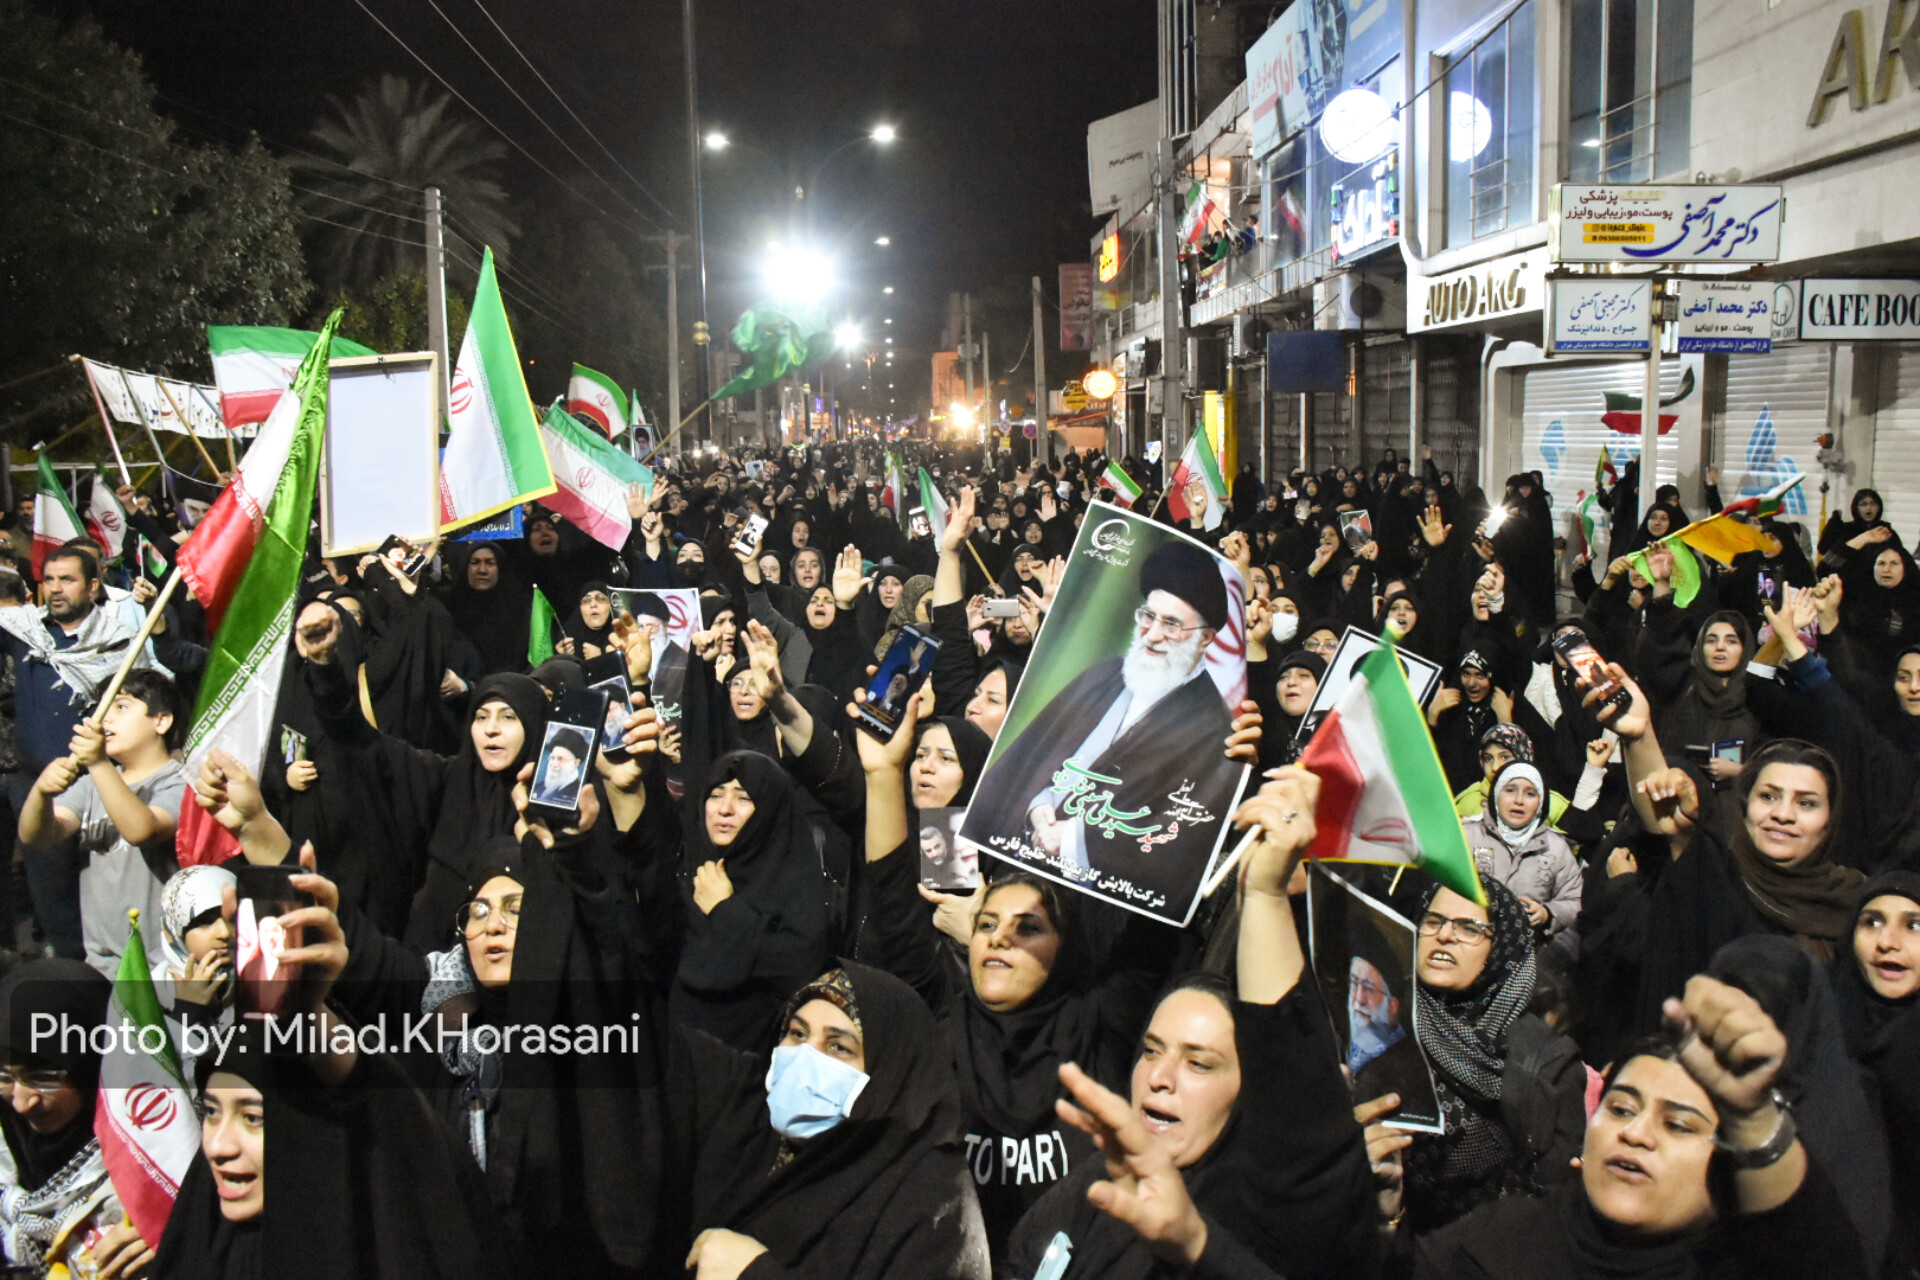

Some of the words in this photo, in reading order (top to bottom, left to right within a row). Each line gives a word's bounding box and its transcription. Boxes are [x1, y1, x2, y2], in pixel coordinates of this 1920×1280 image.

[1580, 189, 1618, 205] پزشکی
[1622, 193, 1727, 258] آصفی
[1694, 217, 1736, 255] محمد
[1722, 199, 1779, 258] دکتر
[1423, 274, 1478, 326] AUTO
[1570, 291, 1602, 320] آصفی
[1610, 283, 1647, 320] دکتر
[1683, 297, 1714, 317] آصفی
[1716, 302, 1744, 314] محمد
[1746, 300, 1768, 318] دکتر
[1808, 293, 1869, 326] CAFE
[1085, 790, 1152, 825] علی
[1099, 818, 1163, 839] سید
[1136, 821, 1179, 852] شهید
[989, 835, 1021, 851] فارس
[1018, 846, 1047, 862] خلیج
[1080, 870, 1102, 882] گاز
[1097, 876, 1135, 899] پالایش
[1133, 889, 1166, 908] شرکت
[964, 1132, 993, 1186] TO
